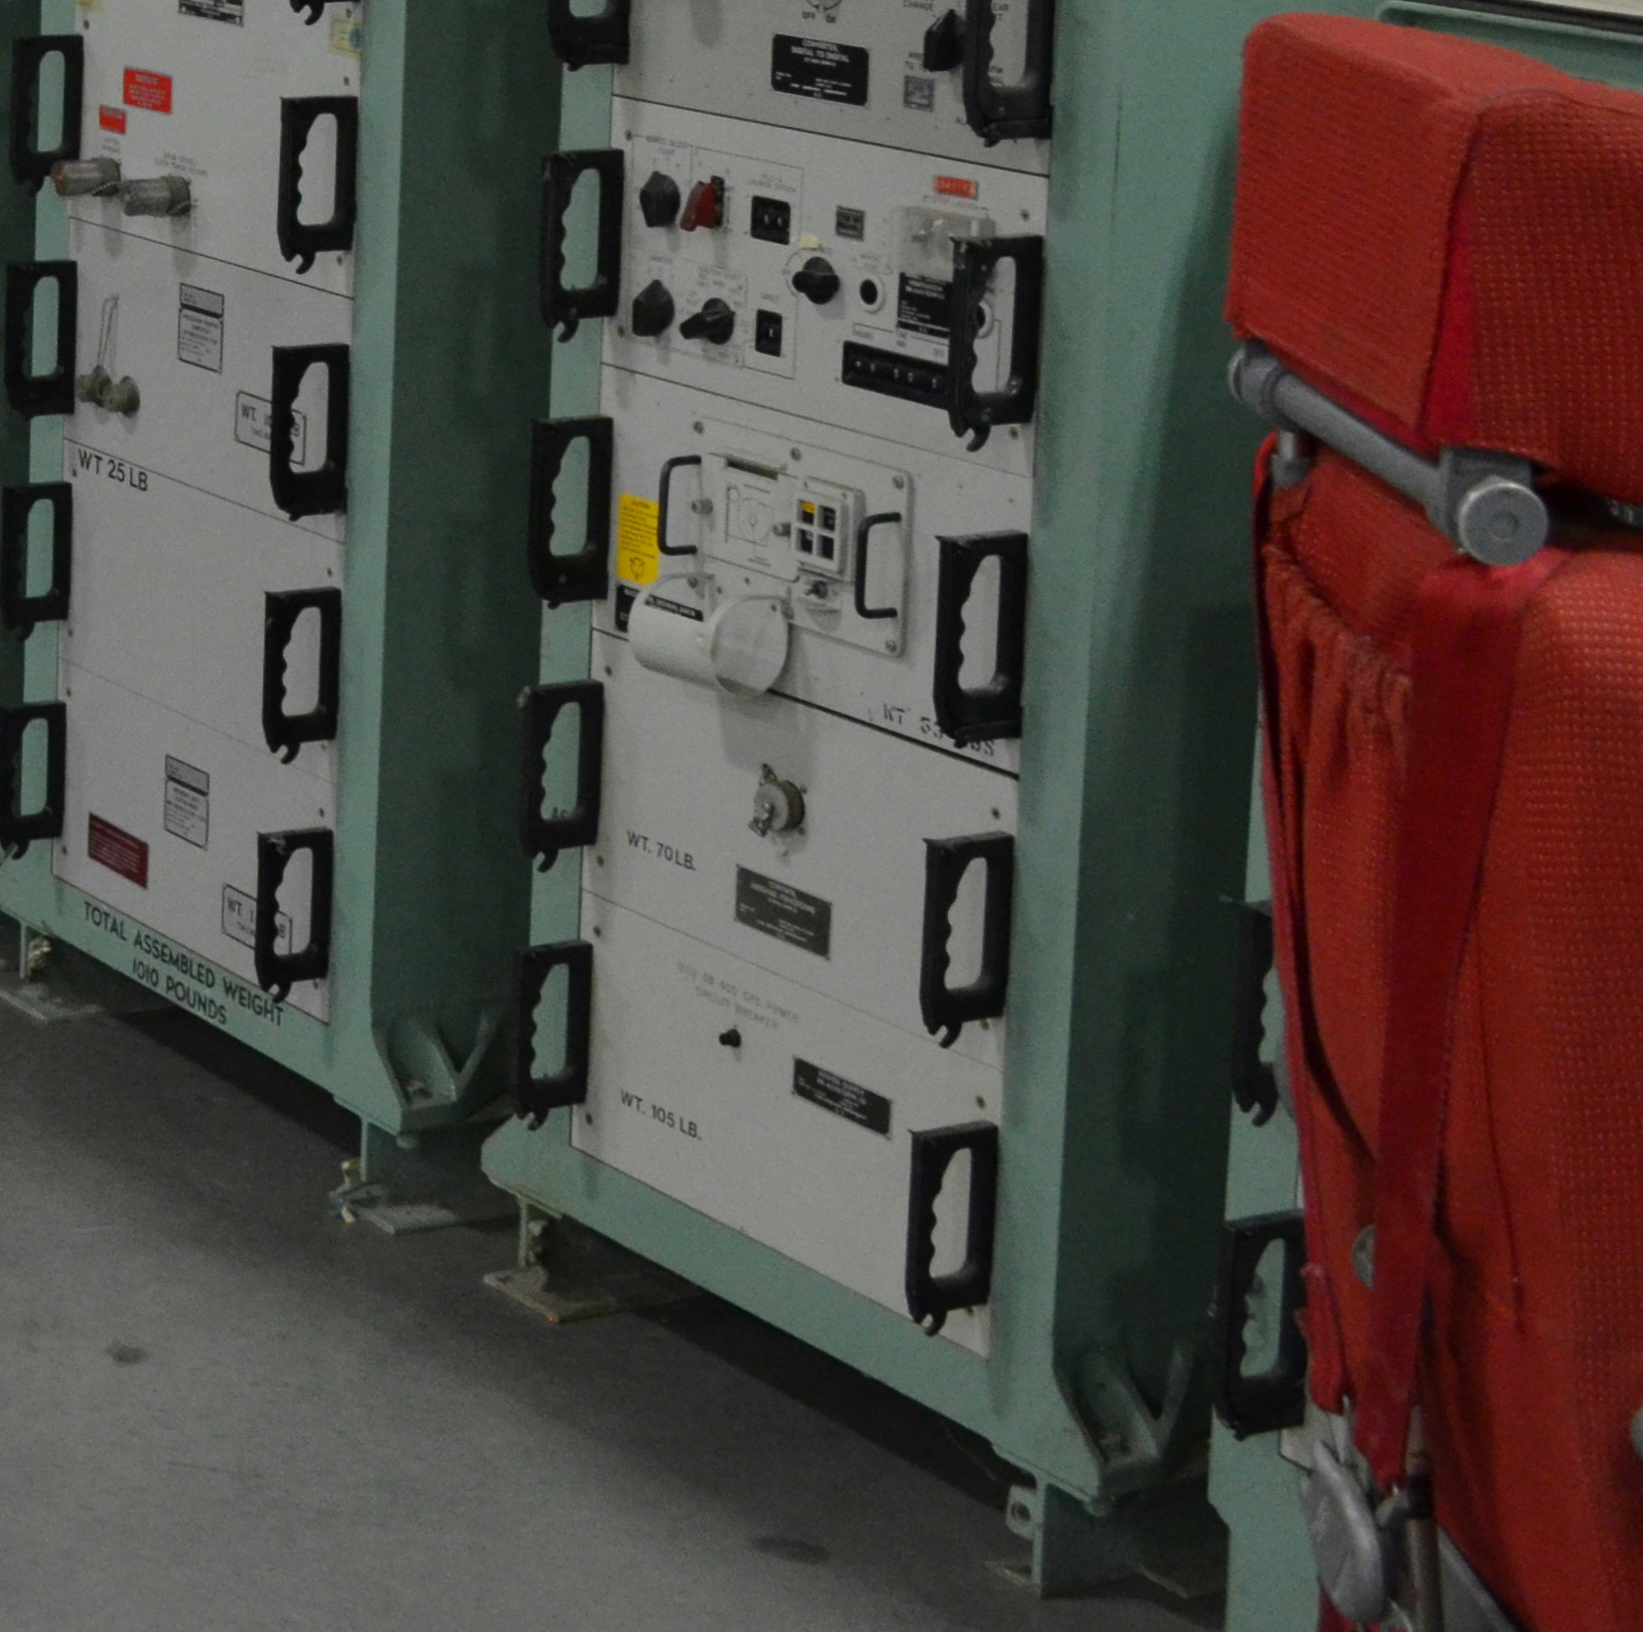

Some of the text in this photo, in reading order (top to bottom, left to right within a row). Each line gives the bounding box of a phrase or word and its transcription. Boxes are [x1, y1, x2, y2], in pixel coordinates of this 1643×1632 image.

[78, 448, 148, 491] WT 25 LB
[627, 830, 651, 854] WT.
[83, 900, 284, 1027] TOTAL ASSEMBLED WEIGHT
[133, 958, 227, 1025] 1010 POUNDS
[620, 1089, 702, 1141] WT. 105 LB.
